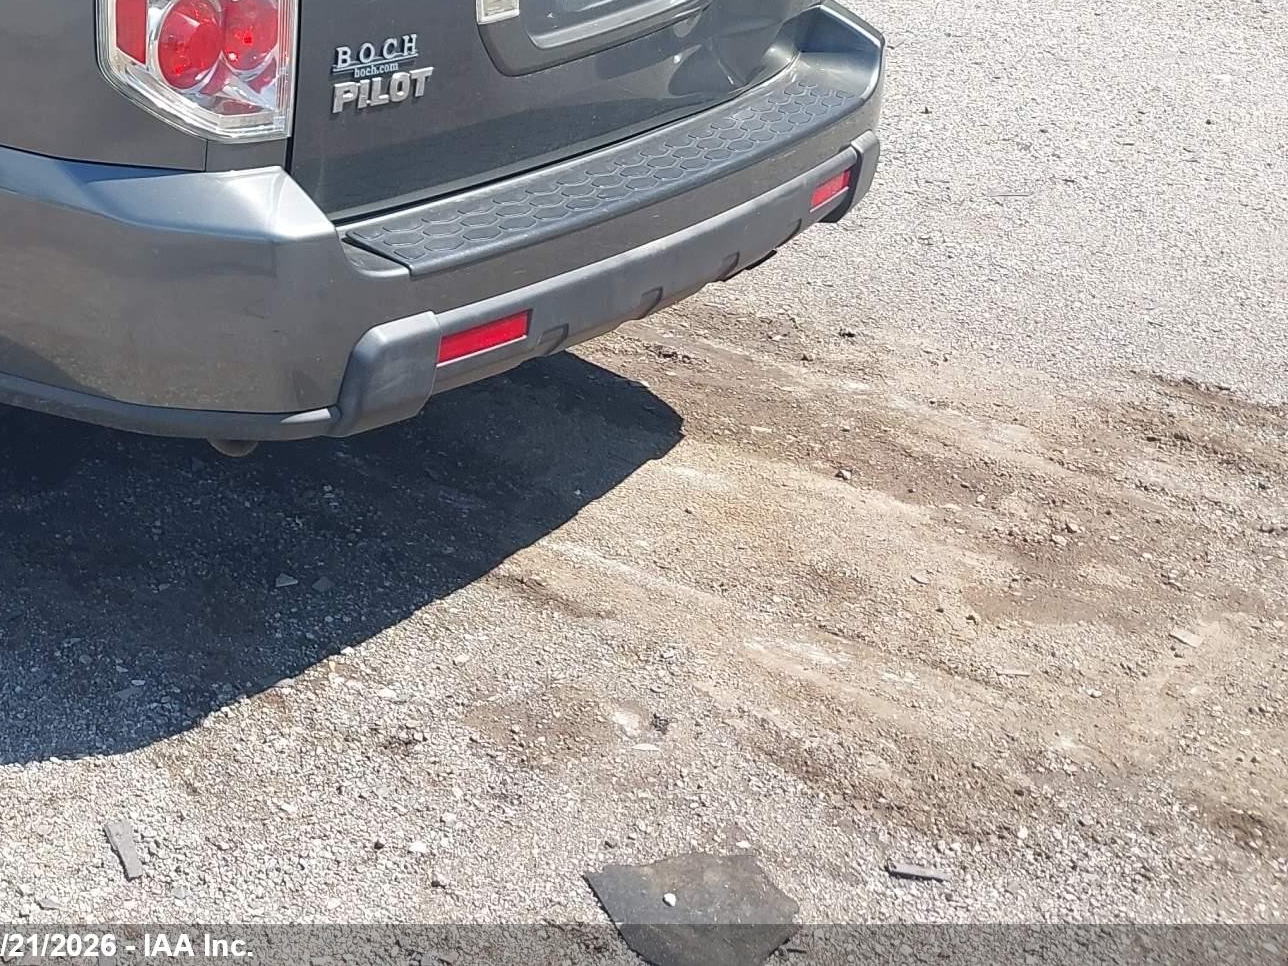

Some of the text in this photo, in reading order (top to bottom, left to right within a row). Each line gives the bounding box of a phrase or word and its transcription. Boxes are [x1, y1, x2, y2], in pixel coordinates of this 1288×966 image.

[335, 34, 418, 68] BOCH
[353, 62, 399, 78] boch.com
[333, 67, 434, 114] PILOT
